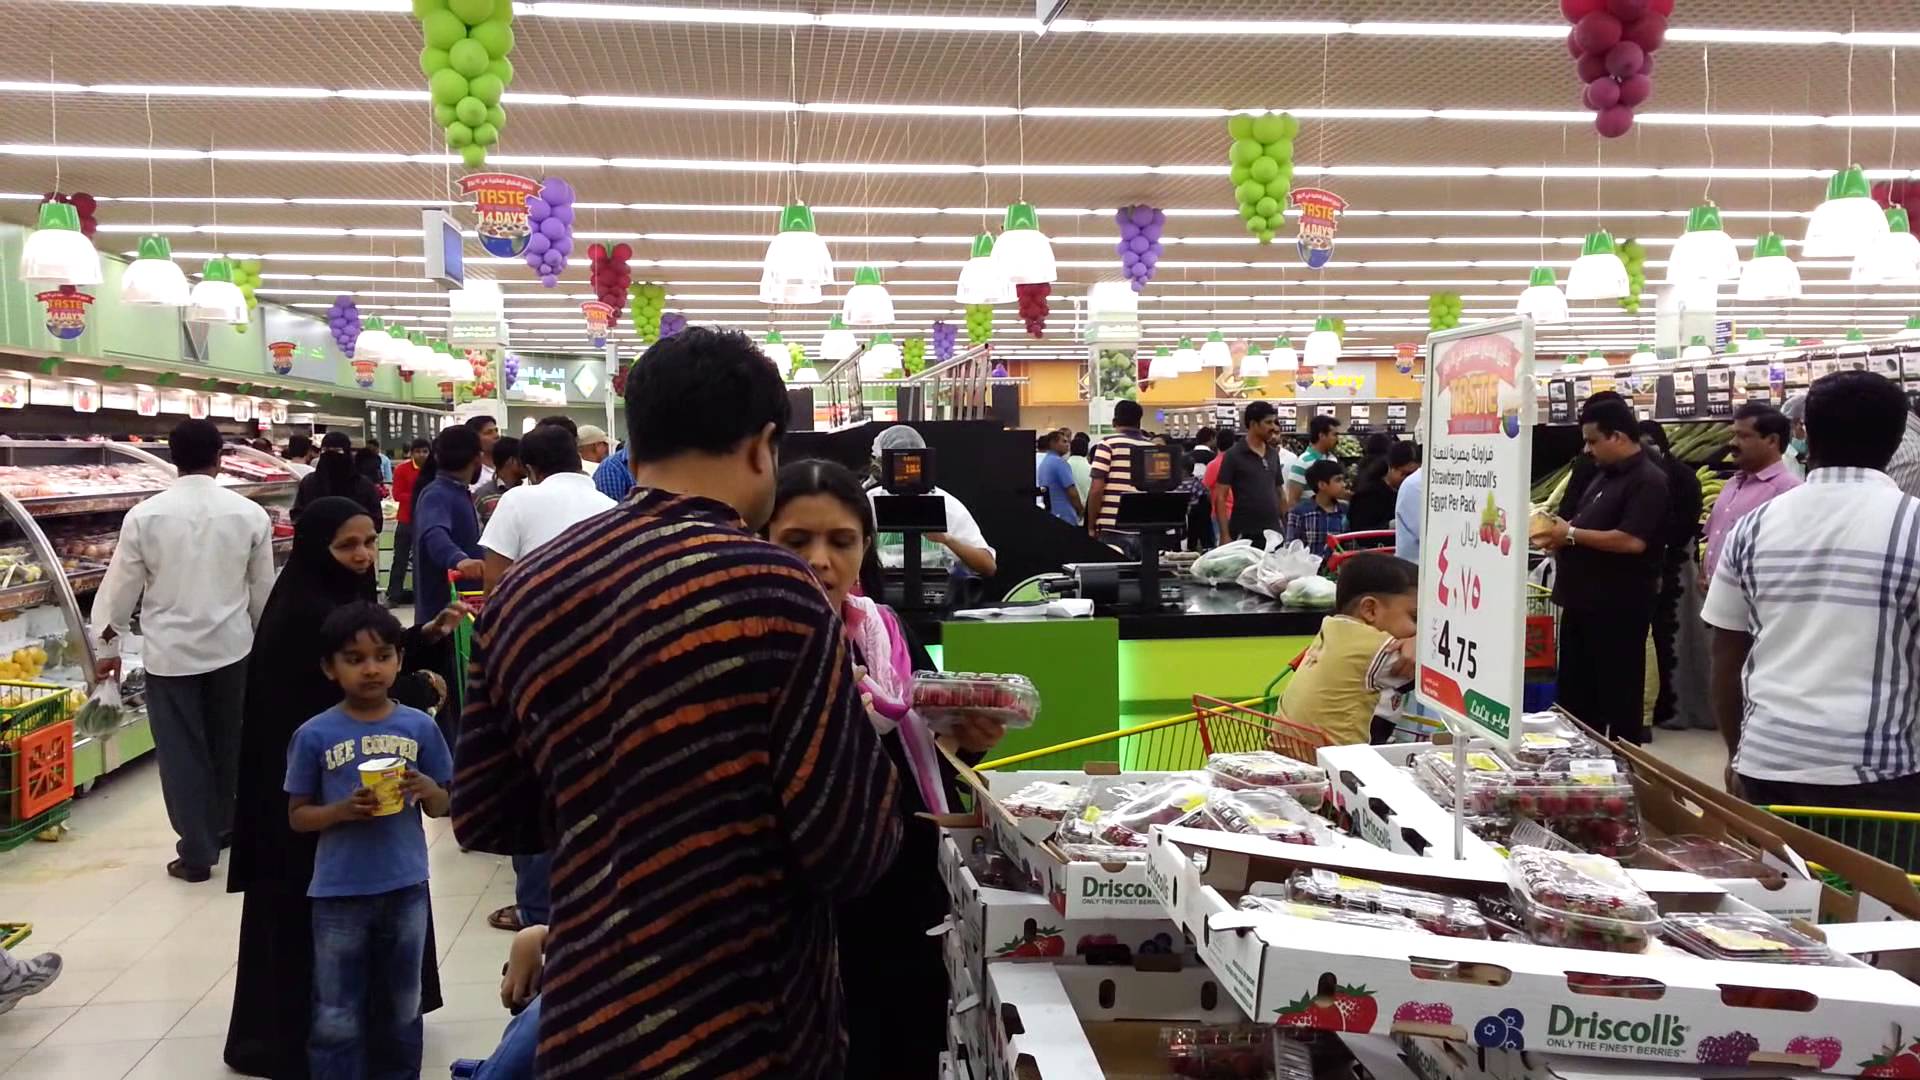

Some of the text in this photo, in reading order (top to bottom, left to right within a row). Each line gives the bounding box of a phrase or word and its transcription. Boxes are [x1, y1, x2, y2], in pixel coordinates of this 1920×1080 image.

[478, 189, 525, 205] TASTE
[495, 211, 525, 225] DAYS
[1302, 203, 1334, 220] TASTE
[1311, 224, 1334, 238] DAYS
[48, 299, 82, 309] TASTE
[1451, 373, 1499, 416] TASTE
[1449, 443, 1470, 464] مصرية
[1471, 443, 1494, 464] فراولة
[1431, 469, 1497, 490] Strawberry Driscoll's
[1430, 492, 1477, 513] Egypt Per Pack
[1460, 522, 1478, 548] ريال
[1438, 619, 1478, 679] 4.75
[325, 735, 418, 770] LEE COOPER
[1548, 1004, 1686, 1047] Driscoll's
[1546, 1038, 1682, 1058] ONLY THE FINEST BERRIES
